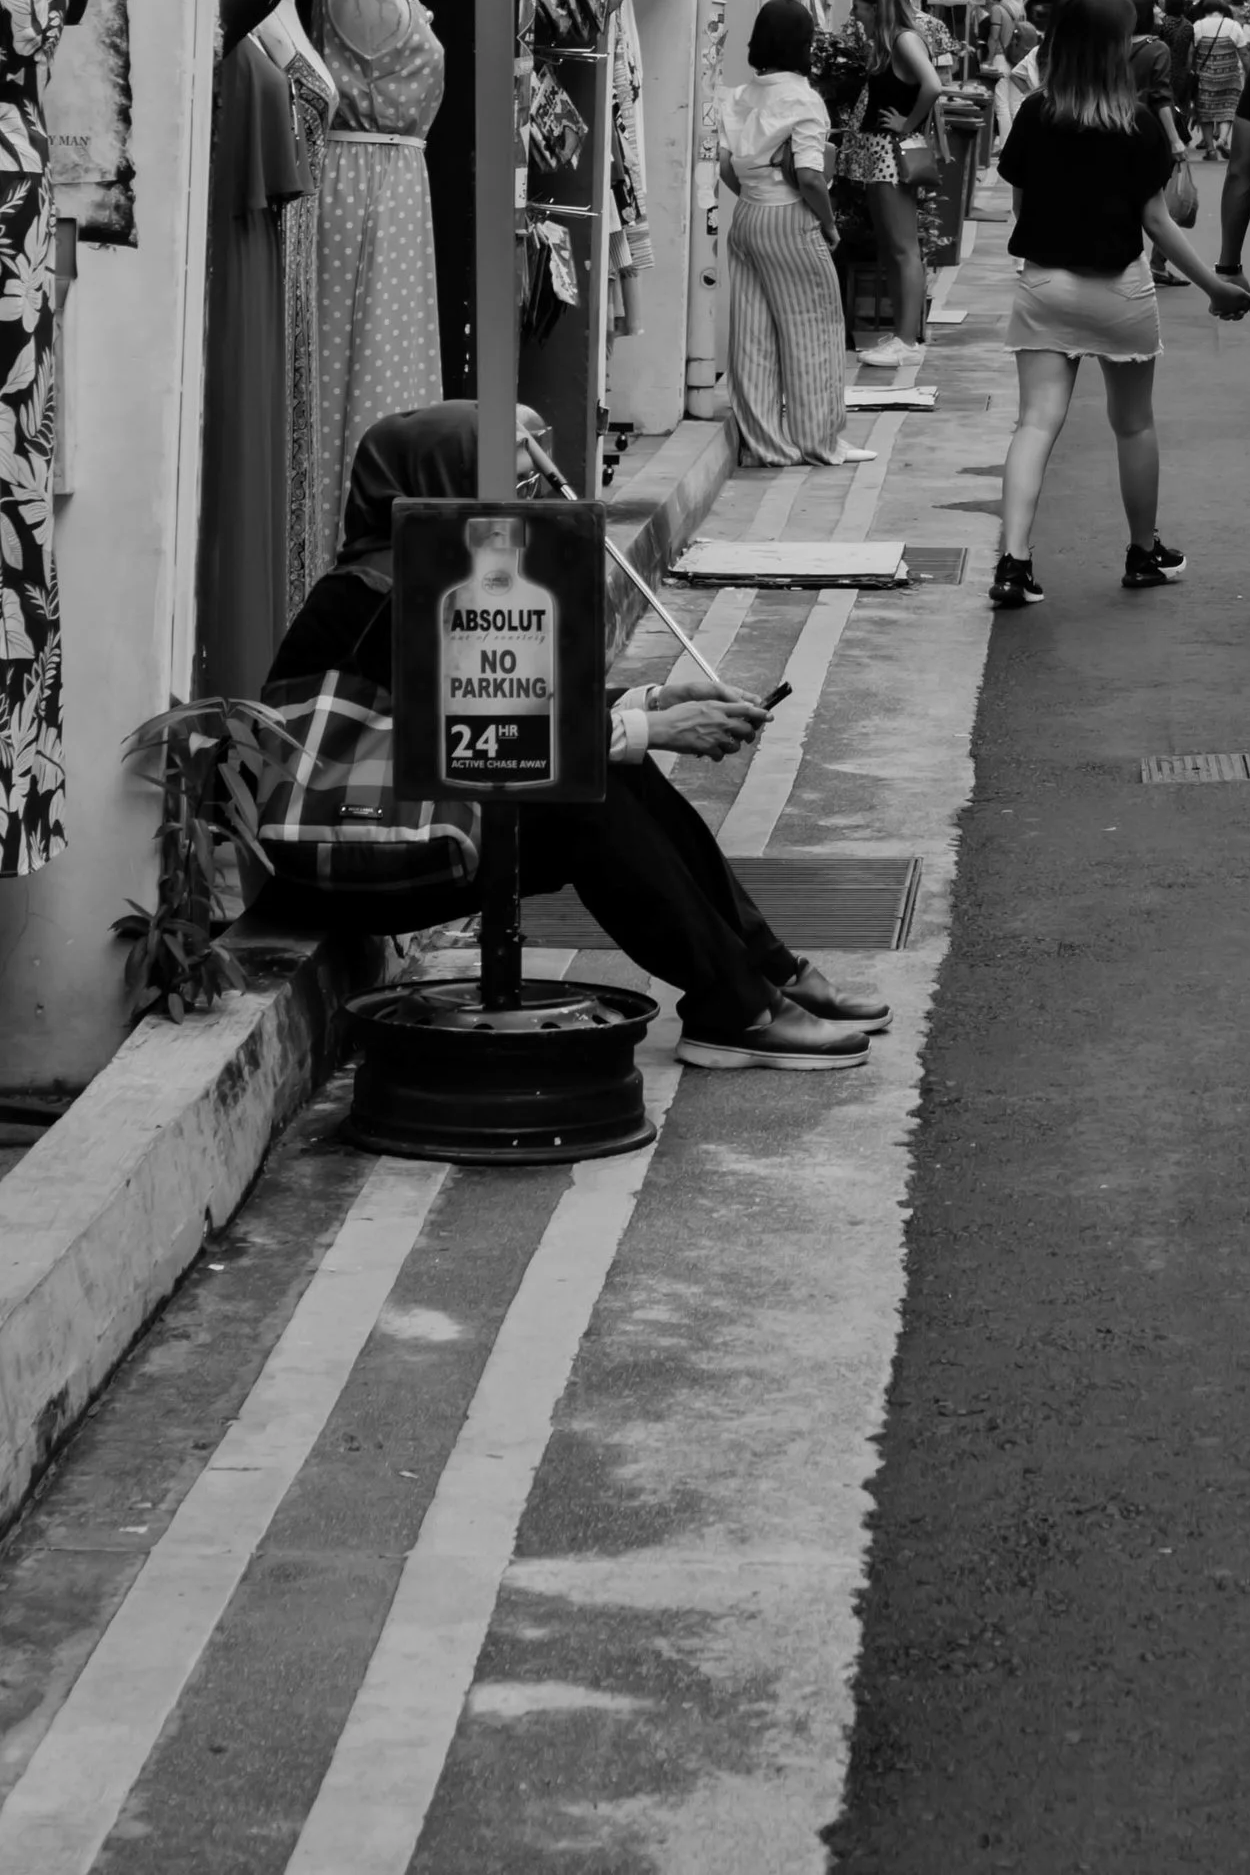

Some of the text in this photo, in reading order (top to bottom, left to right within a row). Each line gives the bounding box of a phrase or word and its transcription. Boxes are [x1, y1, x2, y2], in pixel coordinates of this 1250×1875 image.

[59, 135, 90, 148] MAN
[450, 609, 546, 632] ABSOLUT
[480, 649, 517, 674] NO
[450, 677, 547, 699] PARKING
[451, 759, 547, 770] ACTIVE CHASE AWAY
